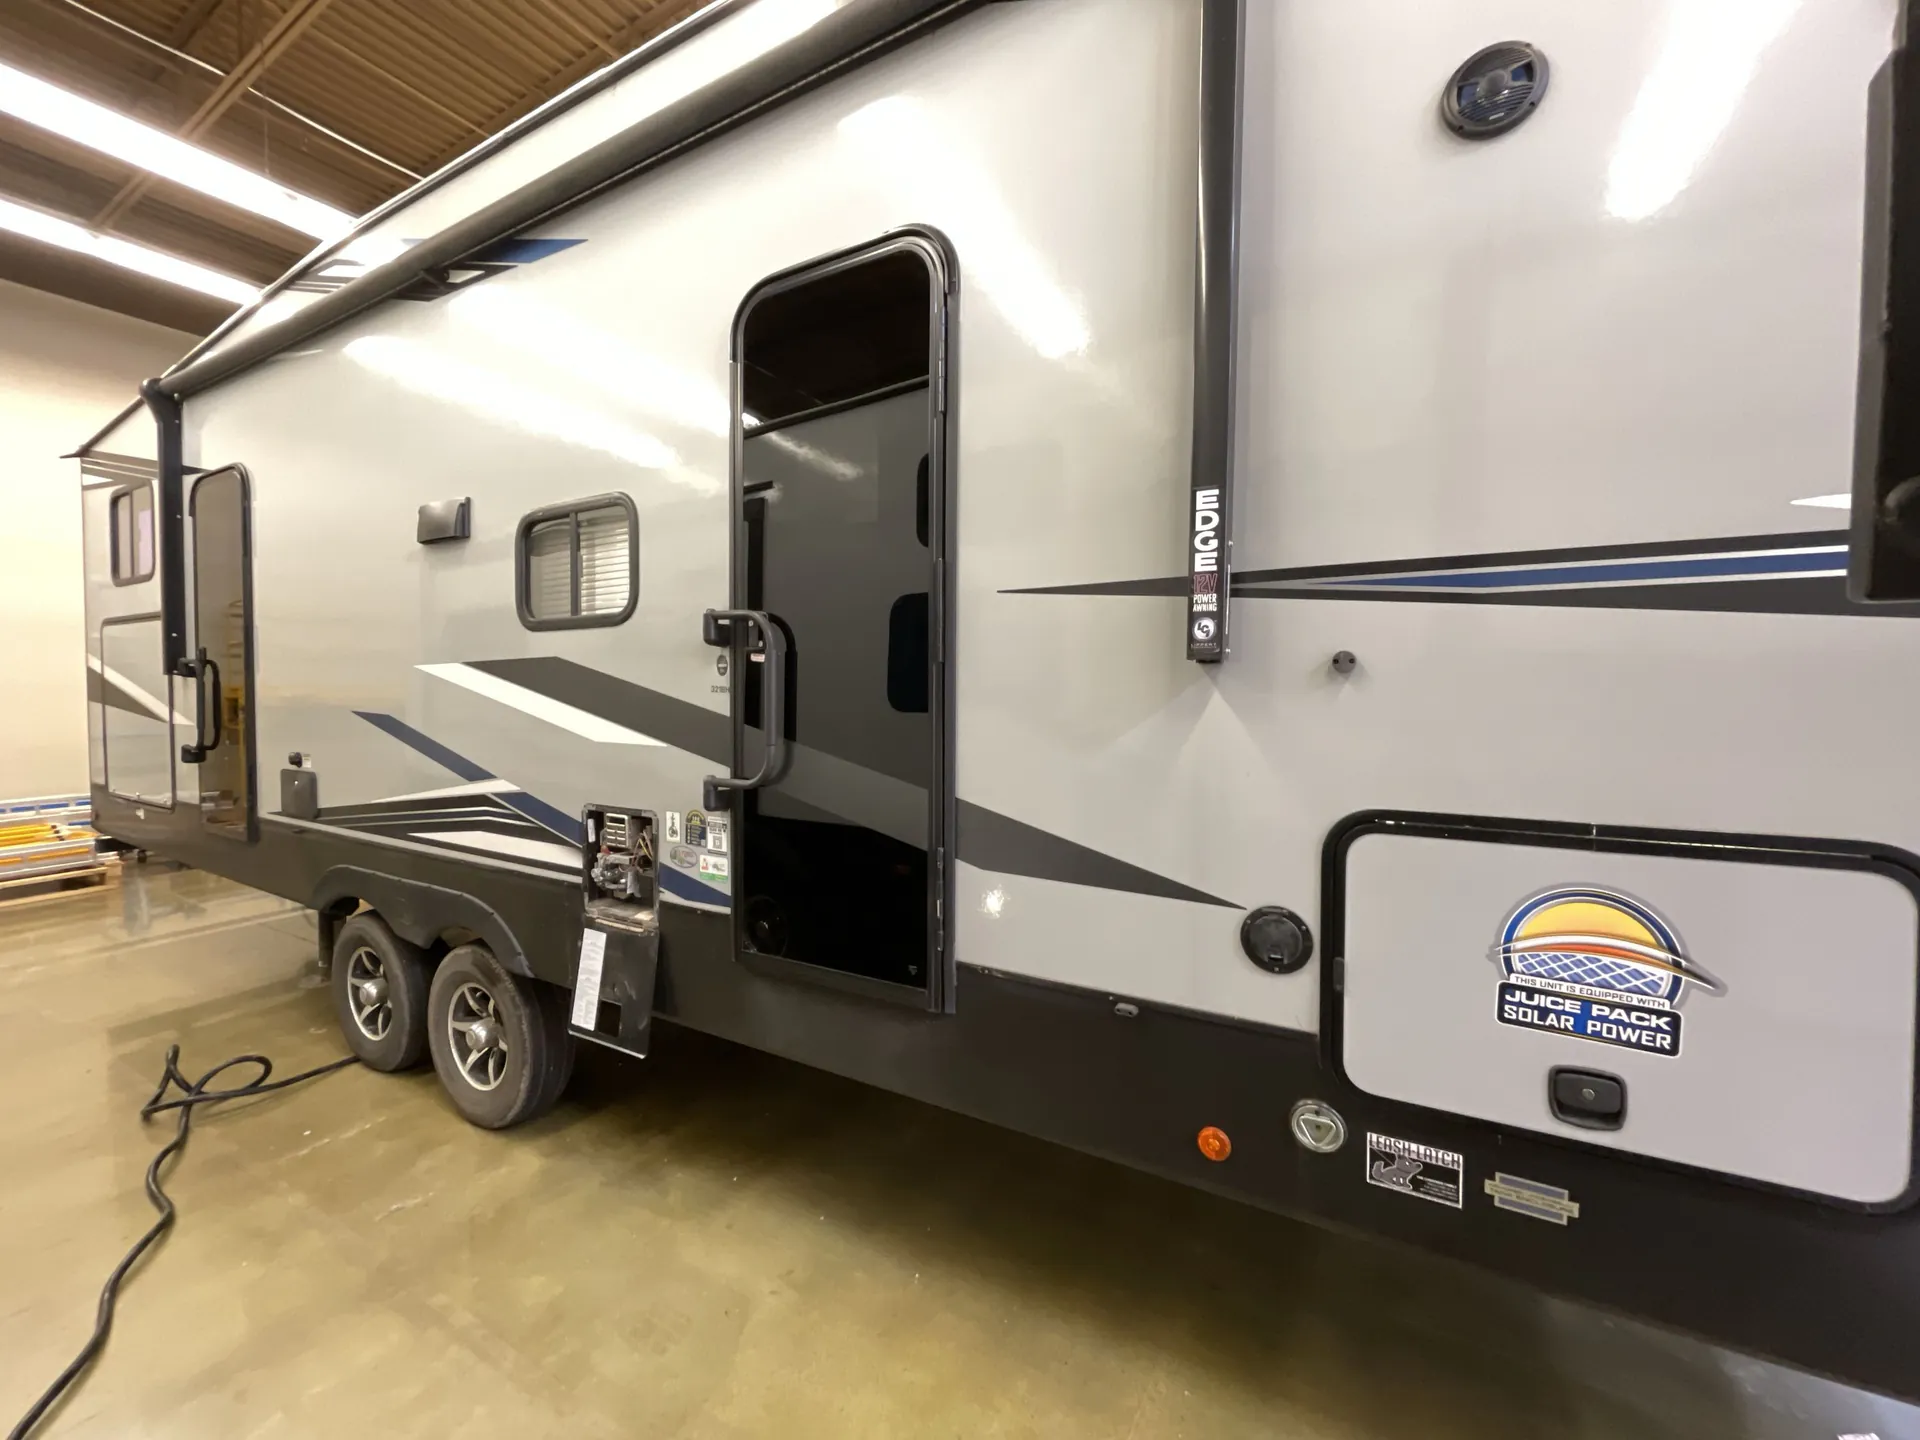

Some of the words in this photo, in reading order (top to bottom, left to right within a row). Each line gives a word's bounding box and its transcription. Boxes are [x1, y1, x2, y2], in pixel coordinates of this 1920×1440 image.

[1194, 489, 1219, 572] EDGE
[1193, 573, 1218, 594] 12V
[1193, 593, 1217, 604] POWER
[1192, 603, 1217, 612] AWNING
[1514, 975, 1537, 986] THIS
[1539, 979, 1563, 991] UNIT
[1566, 984, 1576, 993] IS
[1579, 987, 1633, 1004] EQUIPPED
[1636, 997, 1666, 1009] WITH
[1503, 1004, 1574, 1031] SOLAR
[1586, 1020, 1671, 1050] POWER
[1504, 990, 1581, 1013] JUICE
[1591, 1003, 1672, 1031] PACK
